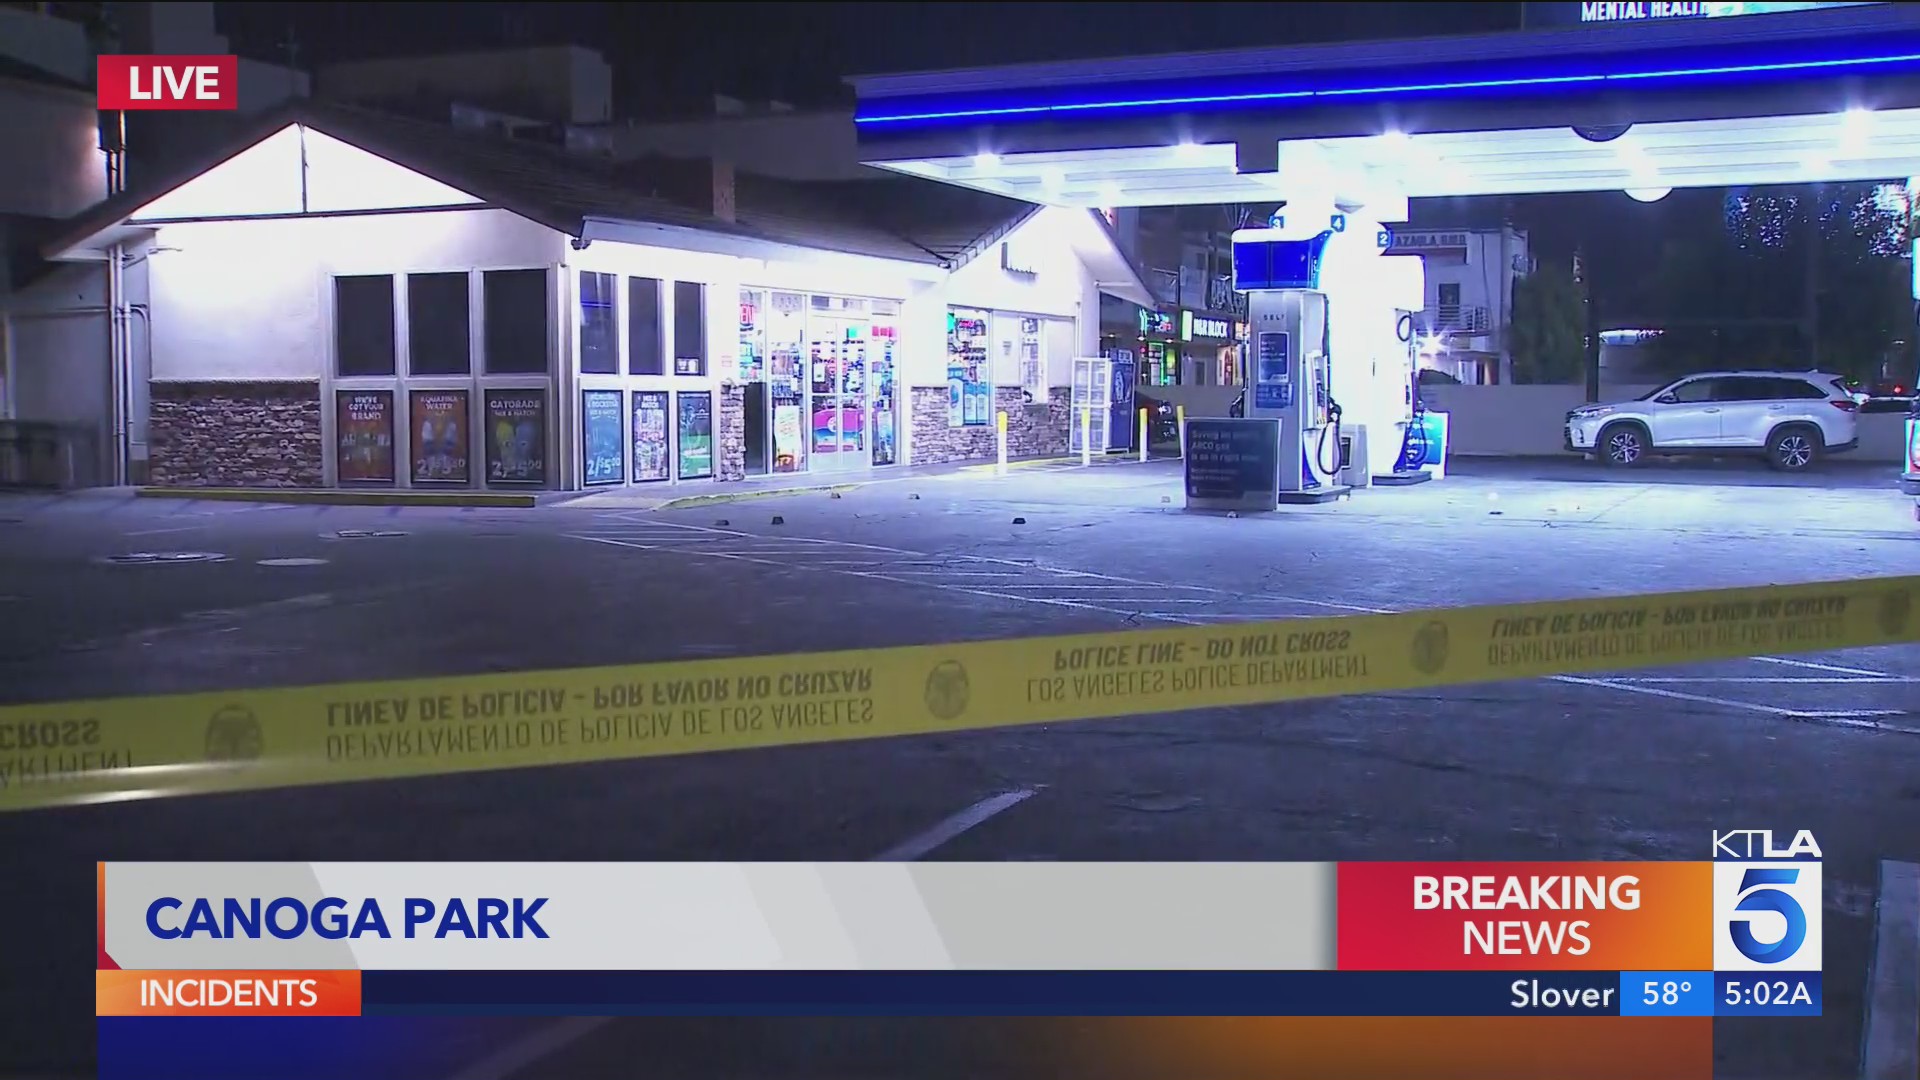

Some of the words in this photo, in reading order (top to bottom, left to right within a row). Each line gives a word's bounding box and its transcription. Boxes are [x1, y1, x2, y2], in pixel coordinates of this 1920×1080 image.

[1581, 2, 1647, 21] MENTAL
[1333, 217, 1343, 229] 4
[1379, 233, 1388, 245] 2
[490, 401, 540, 409] GATORADE
[351, 412, 381, 420] BRAND
[1191, 442, 1214, 450] ARCO
